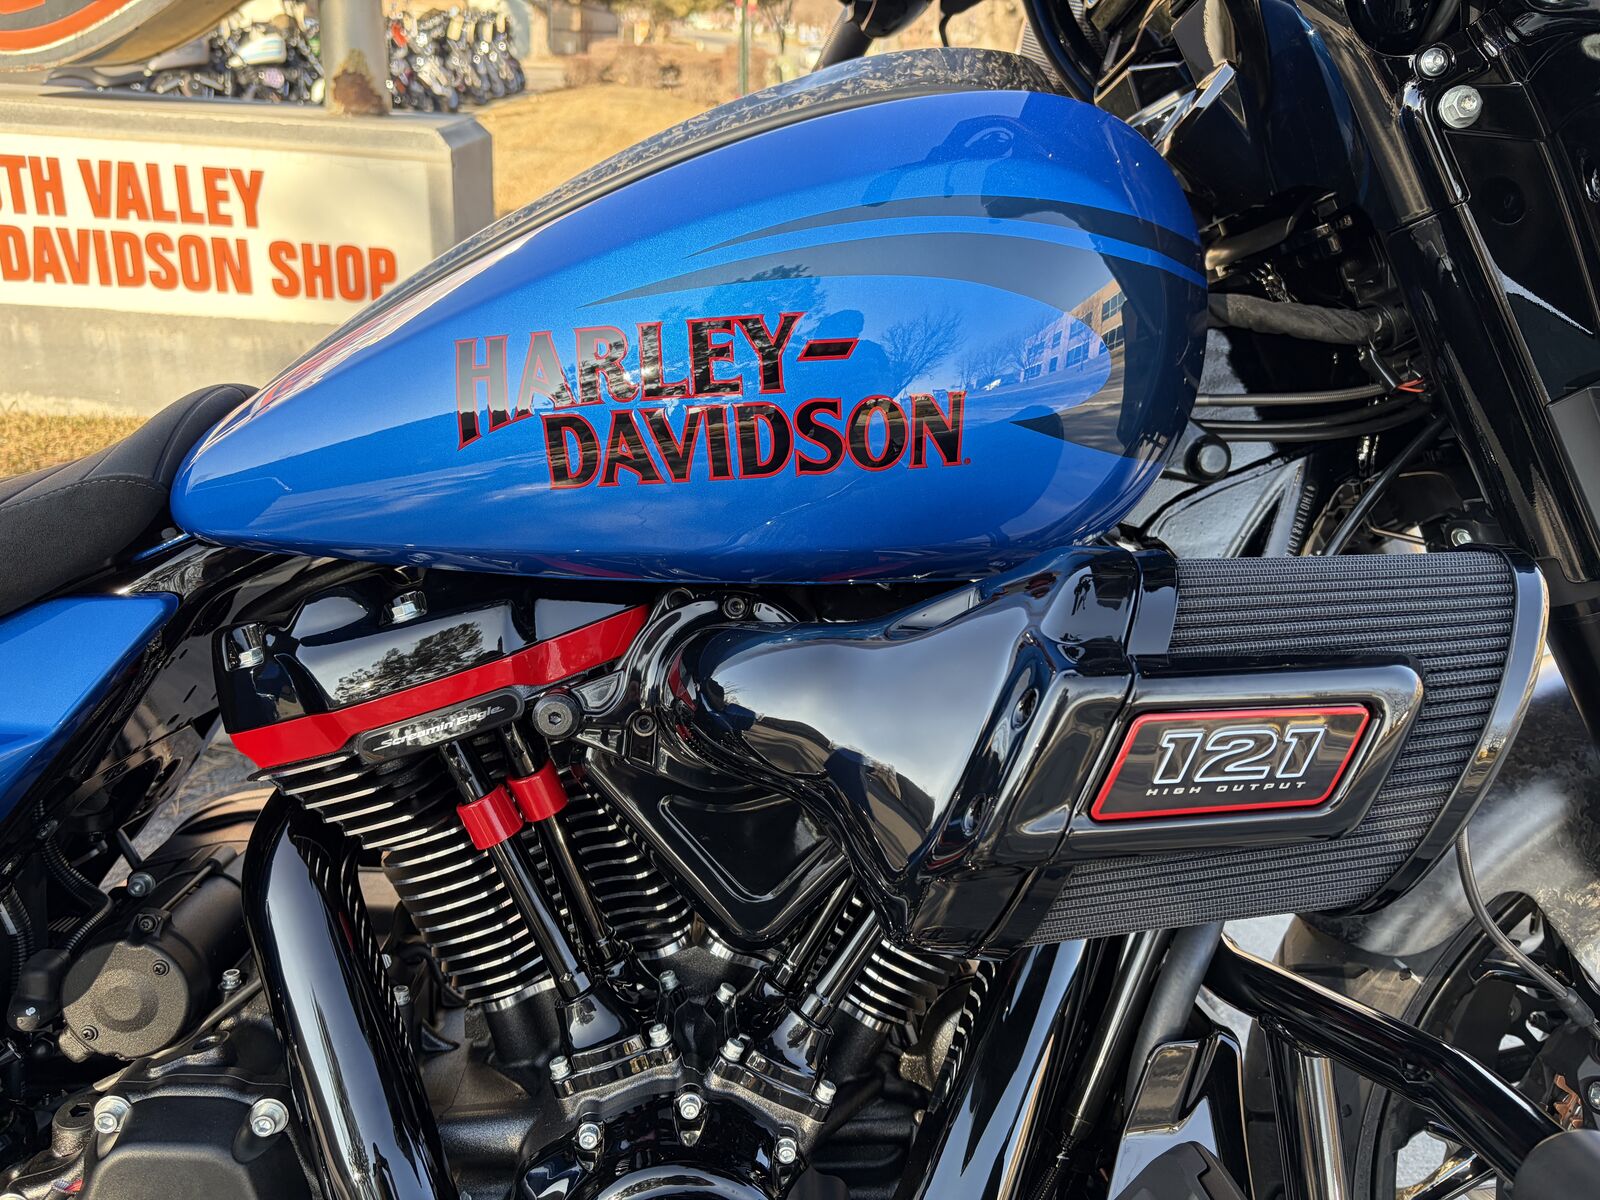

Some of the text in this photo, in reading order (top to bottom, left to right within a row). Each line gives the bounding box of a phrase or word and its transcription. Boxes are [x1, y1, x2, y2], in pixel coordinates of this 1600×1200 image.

[0, 154, 265, 229] TH VALLEY
[0, 224, 397, 302] DAVIDSON SHOP
[454, 311, 861, 451] HARLEY-
[541, 391, 967, 490] DAVIDSON
[457, 705, 504, 726] Eagle
[1145, 781, 1307, 797] HIGH OUTPUT
[1153, 725, 1328, 785] 121
